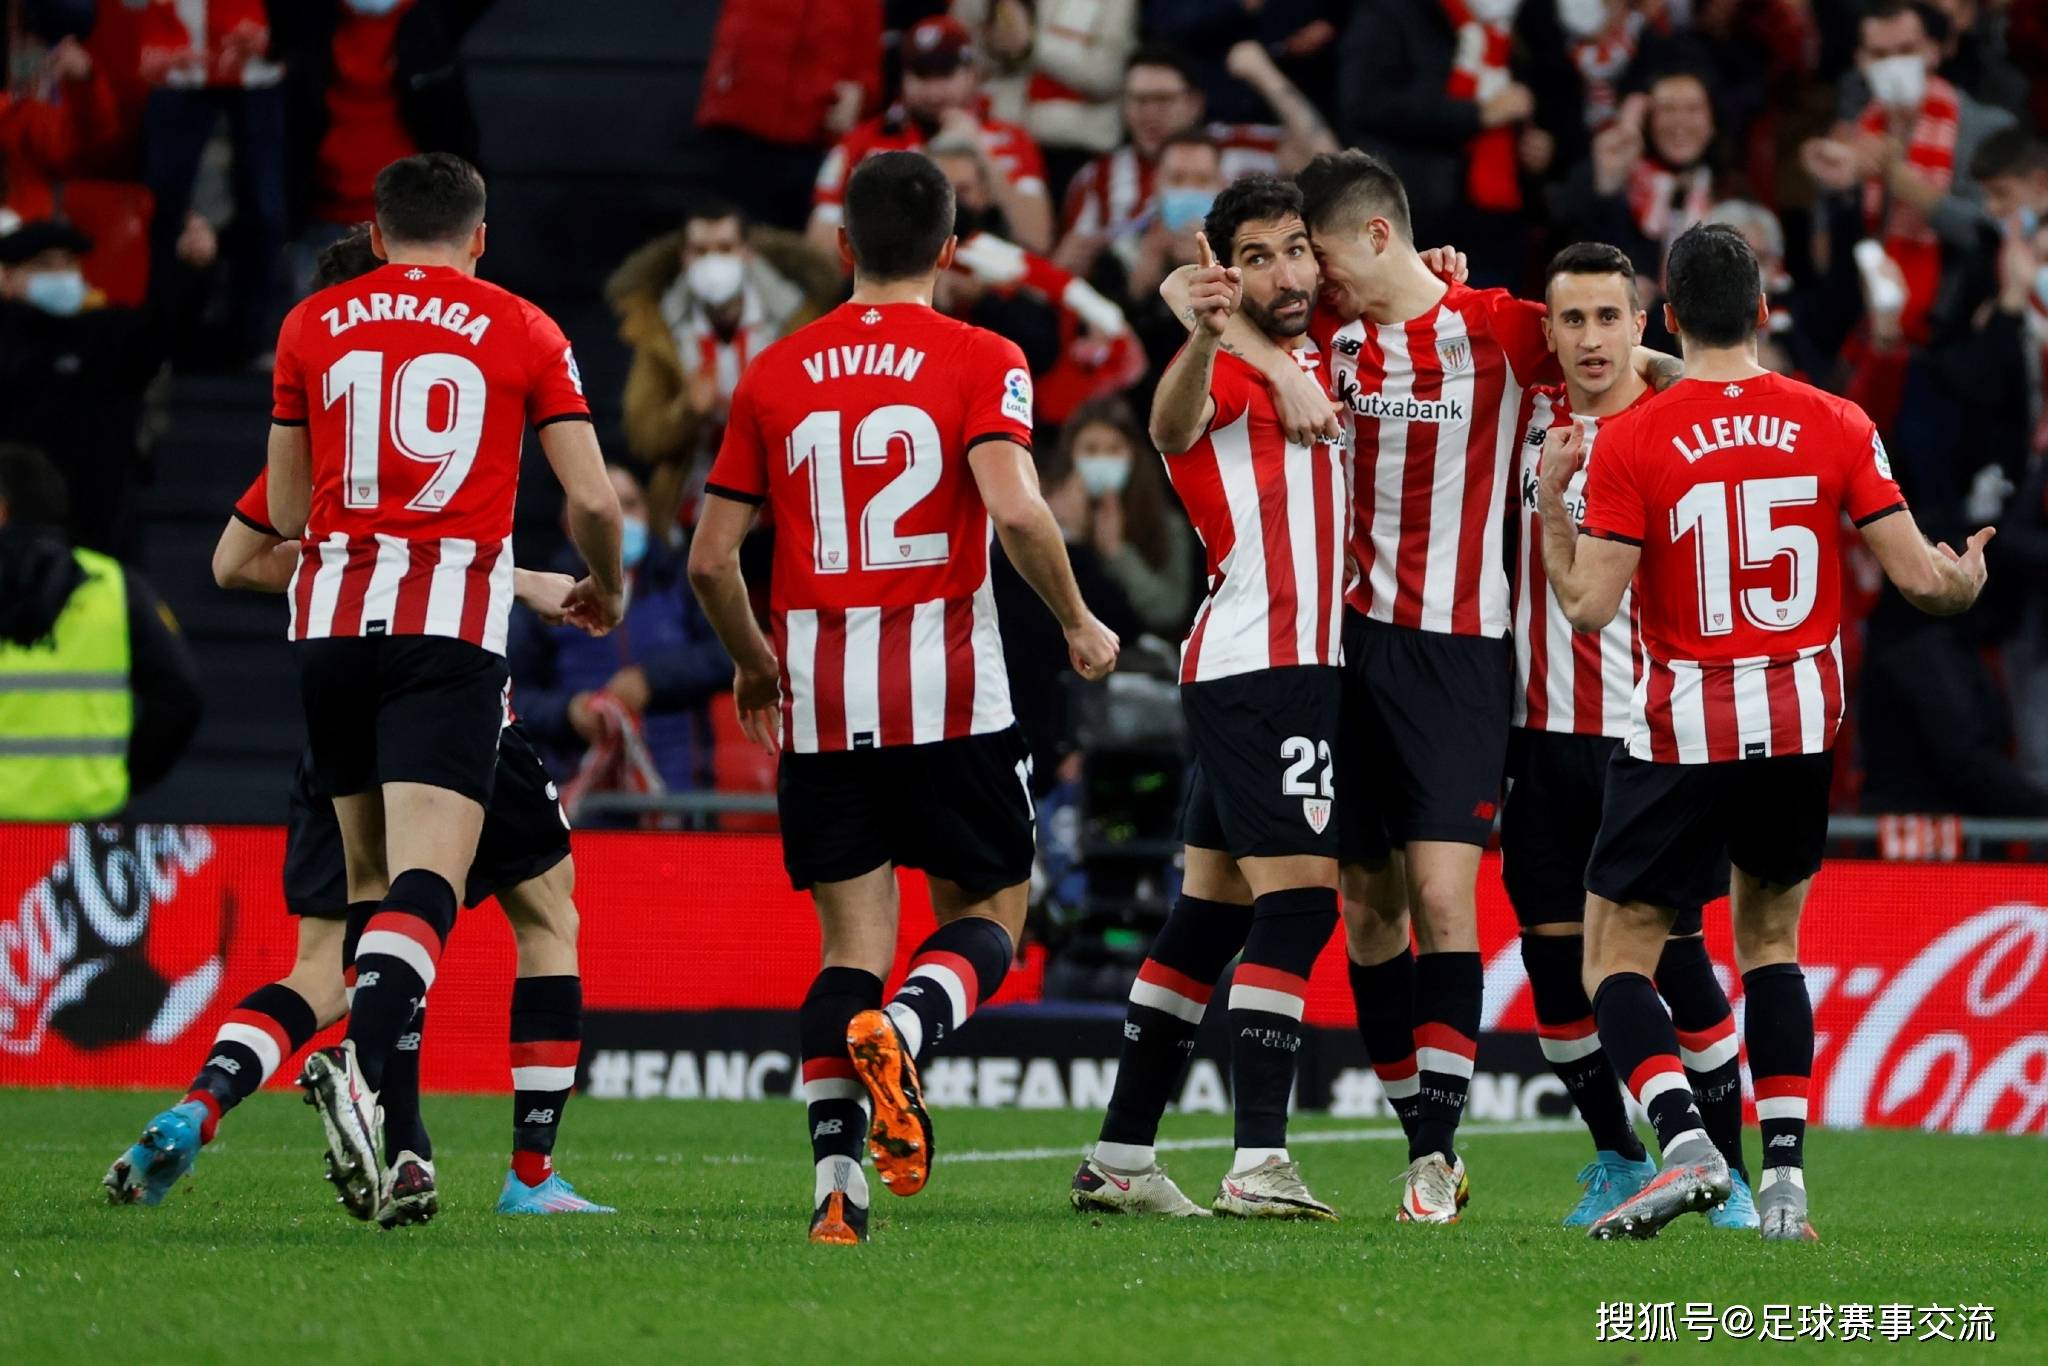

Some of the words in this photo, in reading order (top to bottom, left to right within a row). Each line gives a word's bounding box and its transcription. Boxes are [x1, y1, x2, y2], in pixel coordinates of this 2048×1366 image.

[320, 293, 491, 346] ZARRAGA
[802, 343, 925, 383] VIVIAN
[1338, 369, 1463, 420] Kutxabank
[322, 350, 487, 513] 19
[1672, 415, 1801, 464] I.LEKUE
[785, 404, 949, 574] 12
[1669, 475, 1819, 637] 15
[1280, 736, 1335, 800] 22
[589, 1050, 808, 1100] #FANC
